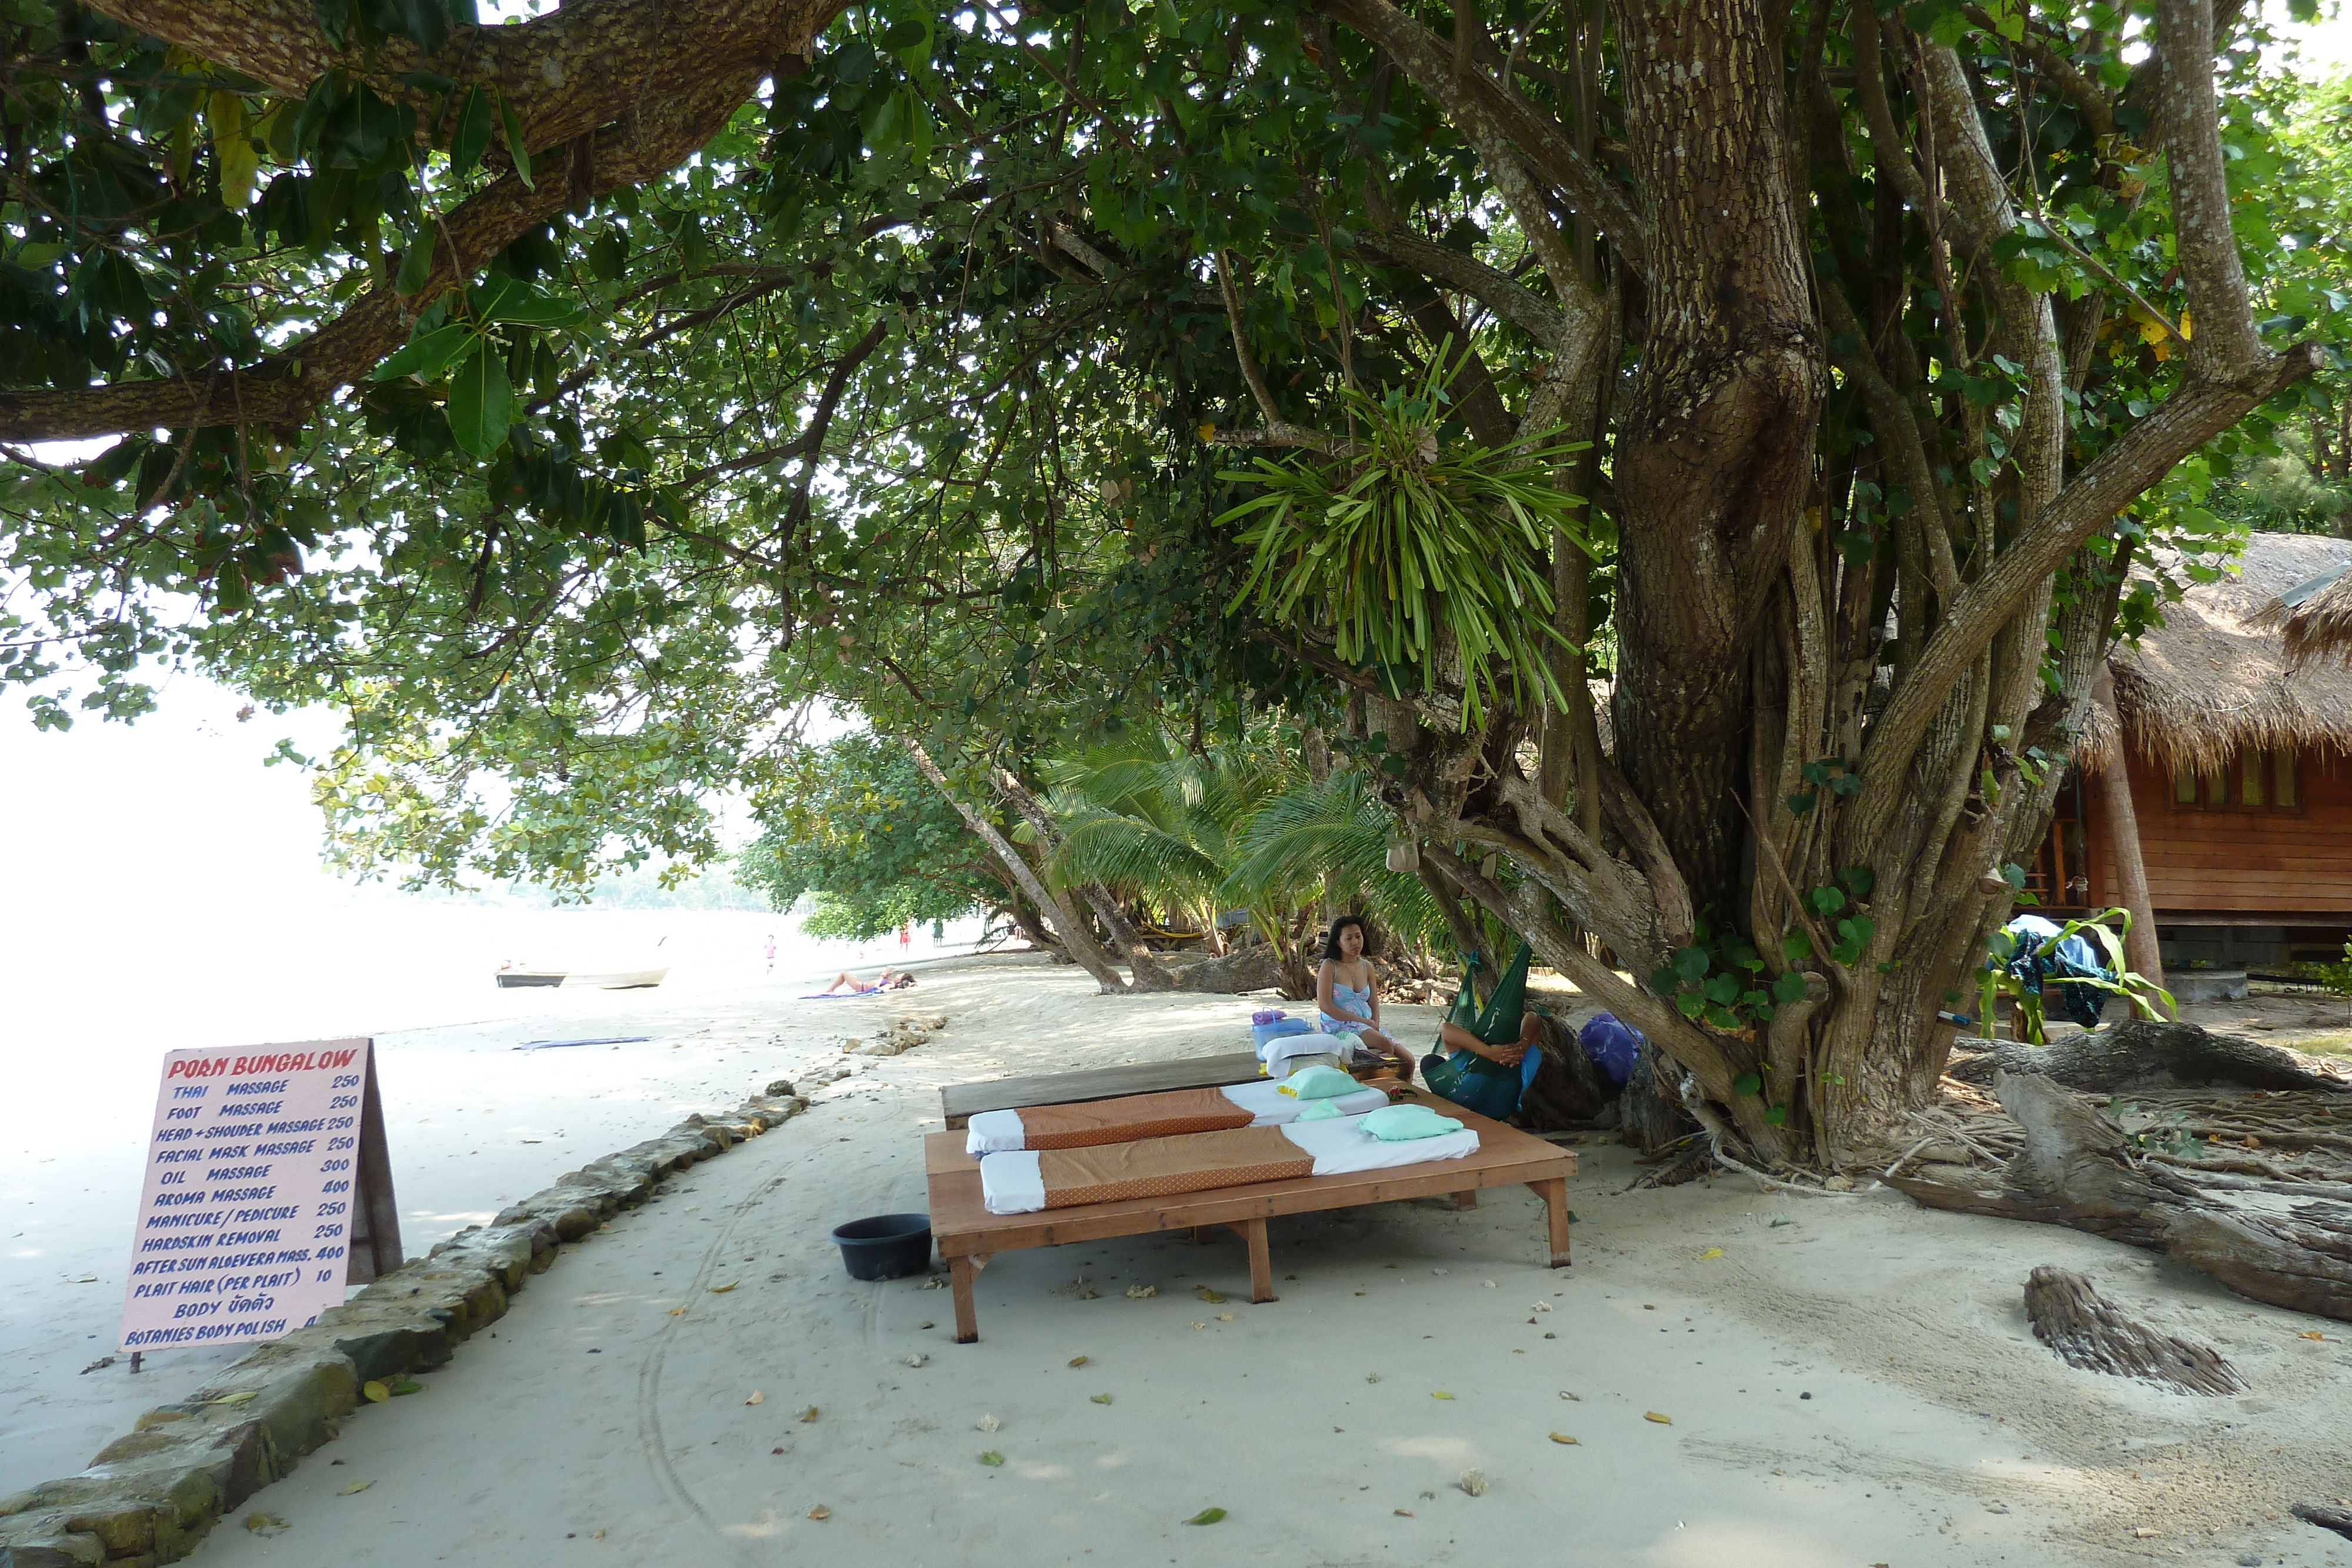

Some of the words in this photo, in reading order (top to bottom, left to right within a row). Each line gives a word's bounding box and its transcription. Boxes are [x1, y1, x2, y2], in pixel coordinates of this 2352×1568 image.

[168, 1058, 229, 1079] PORN
[230, 1048, 359, 1076] BUNGALOW
[174, 1086, 208, 1098] THAI
[226, 1080, 287, 1095] MASSAGE
[332, 1075, 359, 1088] 250
[167, 1106, 202, 1119] FOOT
[219, 1101, 283, 1116] MASSAGE
[330, 1096, 357, 1109] 250
[156, 1128, 192, 1142] HEAD
[267, 1118, 325, 1133] MASSAGE
[328, 1117, 353, 1130] 250
[156, 1149, 203, 1163] FACIAL
[209, 1146, 248, 1159] MASK
[255, 1139, 316, 1155] MASSAGE
[328, 1137, 354, 1151] 250
[161, 1172, 185, 1184] OIL
[206, 1165, 271, 1181] MASSAGE
[320, 1159, 349, 1172] 300
[154, 1191, 205, 1206] AROMA
[211, 1185, 277, 1202] MASSAGE
[323, 1179, 349, 1193] 400
[318, 1202, 346, 1216] 250
[142, 1235, 213, 1252] HARDSKIN
[216, 1229, 280, 1246] REMOVAL
[314, 1224, 343, 1238] 250
[276, 1249, 311, 1263] MASS.
[316, 1246, 344, 1259] 400
[135, 1282, 178, 1298] PLAIT
[179, 1280, 215, 1294] HAIR
[217, 1276, 250, 1294] (PER
[252, 1266, 300, 1288] PLAIT)
[317, 1270, 331, 1282] 10
[173, 1302, 221, 1319] BODY
[125, 1326, 194, 1345] BOTANIES
[195, 1323, 235, 1340] BODY
[235, 1319, 286, 1335] POLISH
